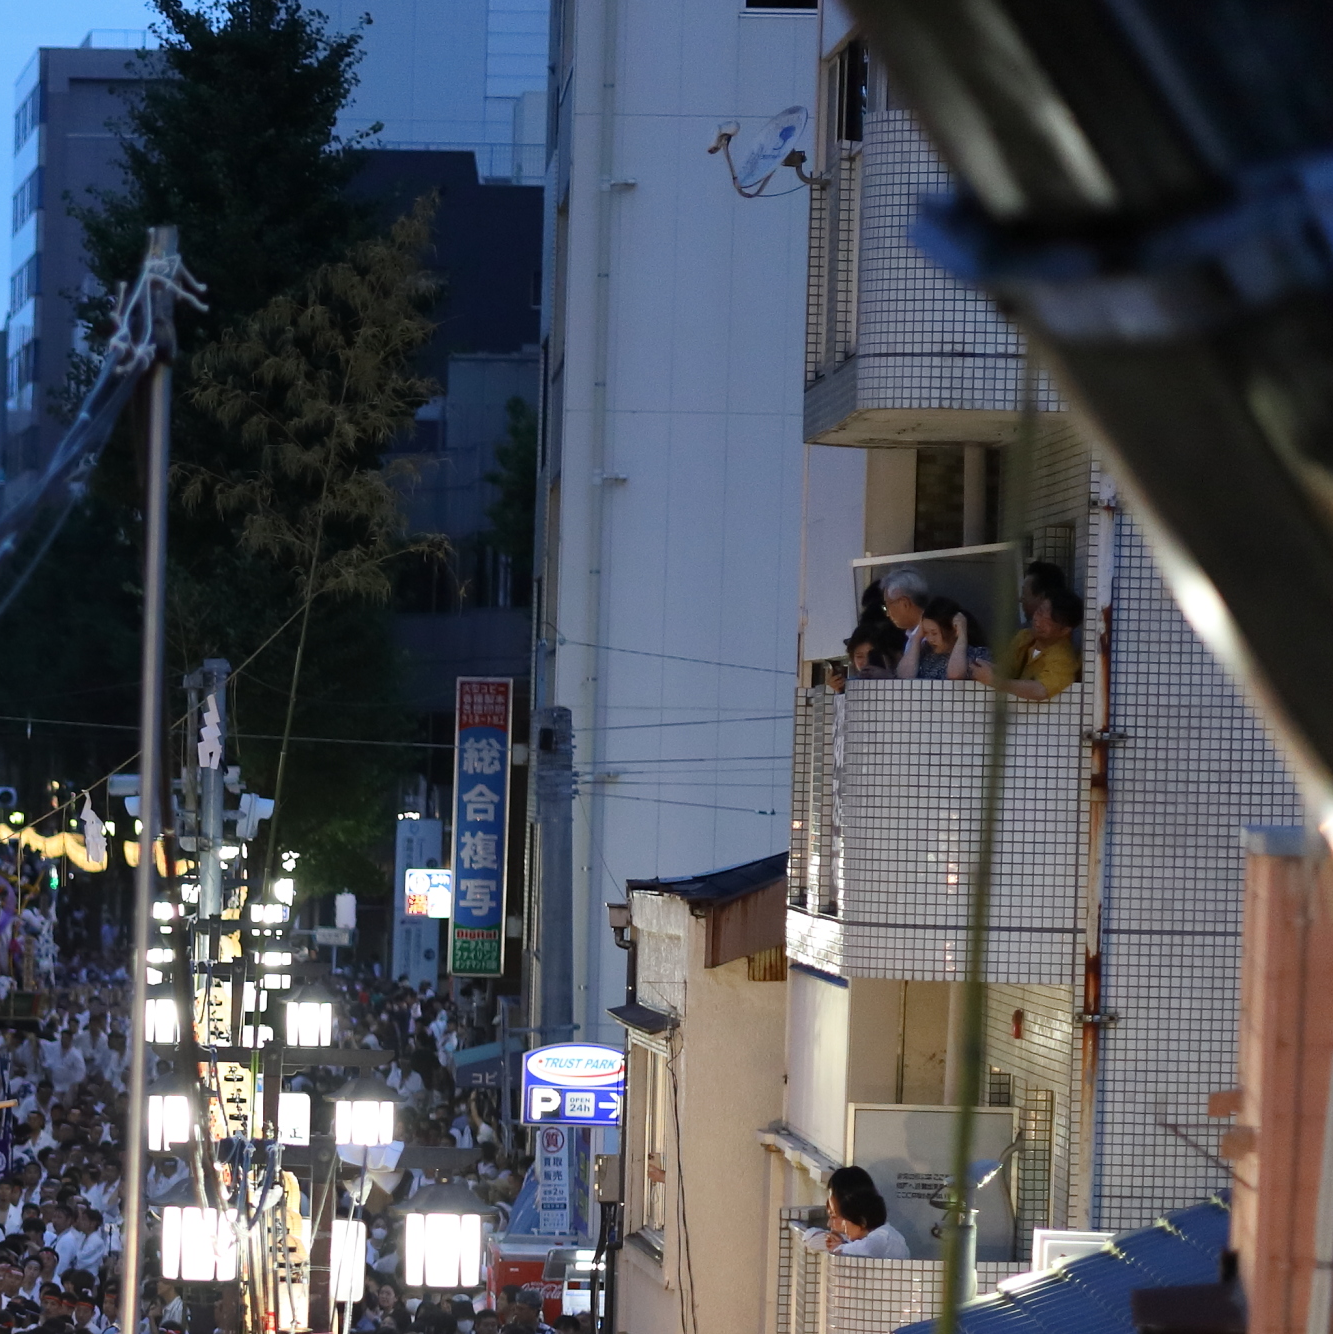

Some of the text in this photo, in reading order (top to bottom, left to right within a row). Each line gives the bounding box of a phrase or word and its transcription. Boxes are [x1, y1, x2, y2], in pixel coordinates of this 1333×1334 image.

[460, 738, 501, 916] 総合複写
[456, 928, 499, 941] Digital
[542, 1056, 616, 1070] TRUST PARK
[532, 1088, 561, 1119] P
[569, 1104, 590, 1113] 24h
